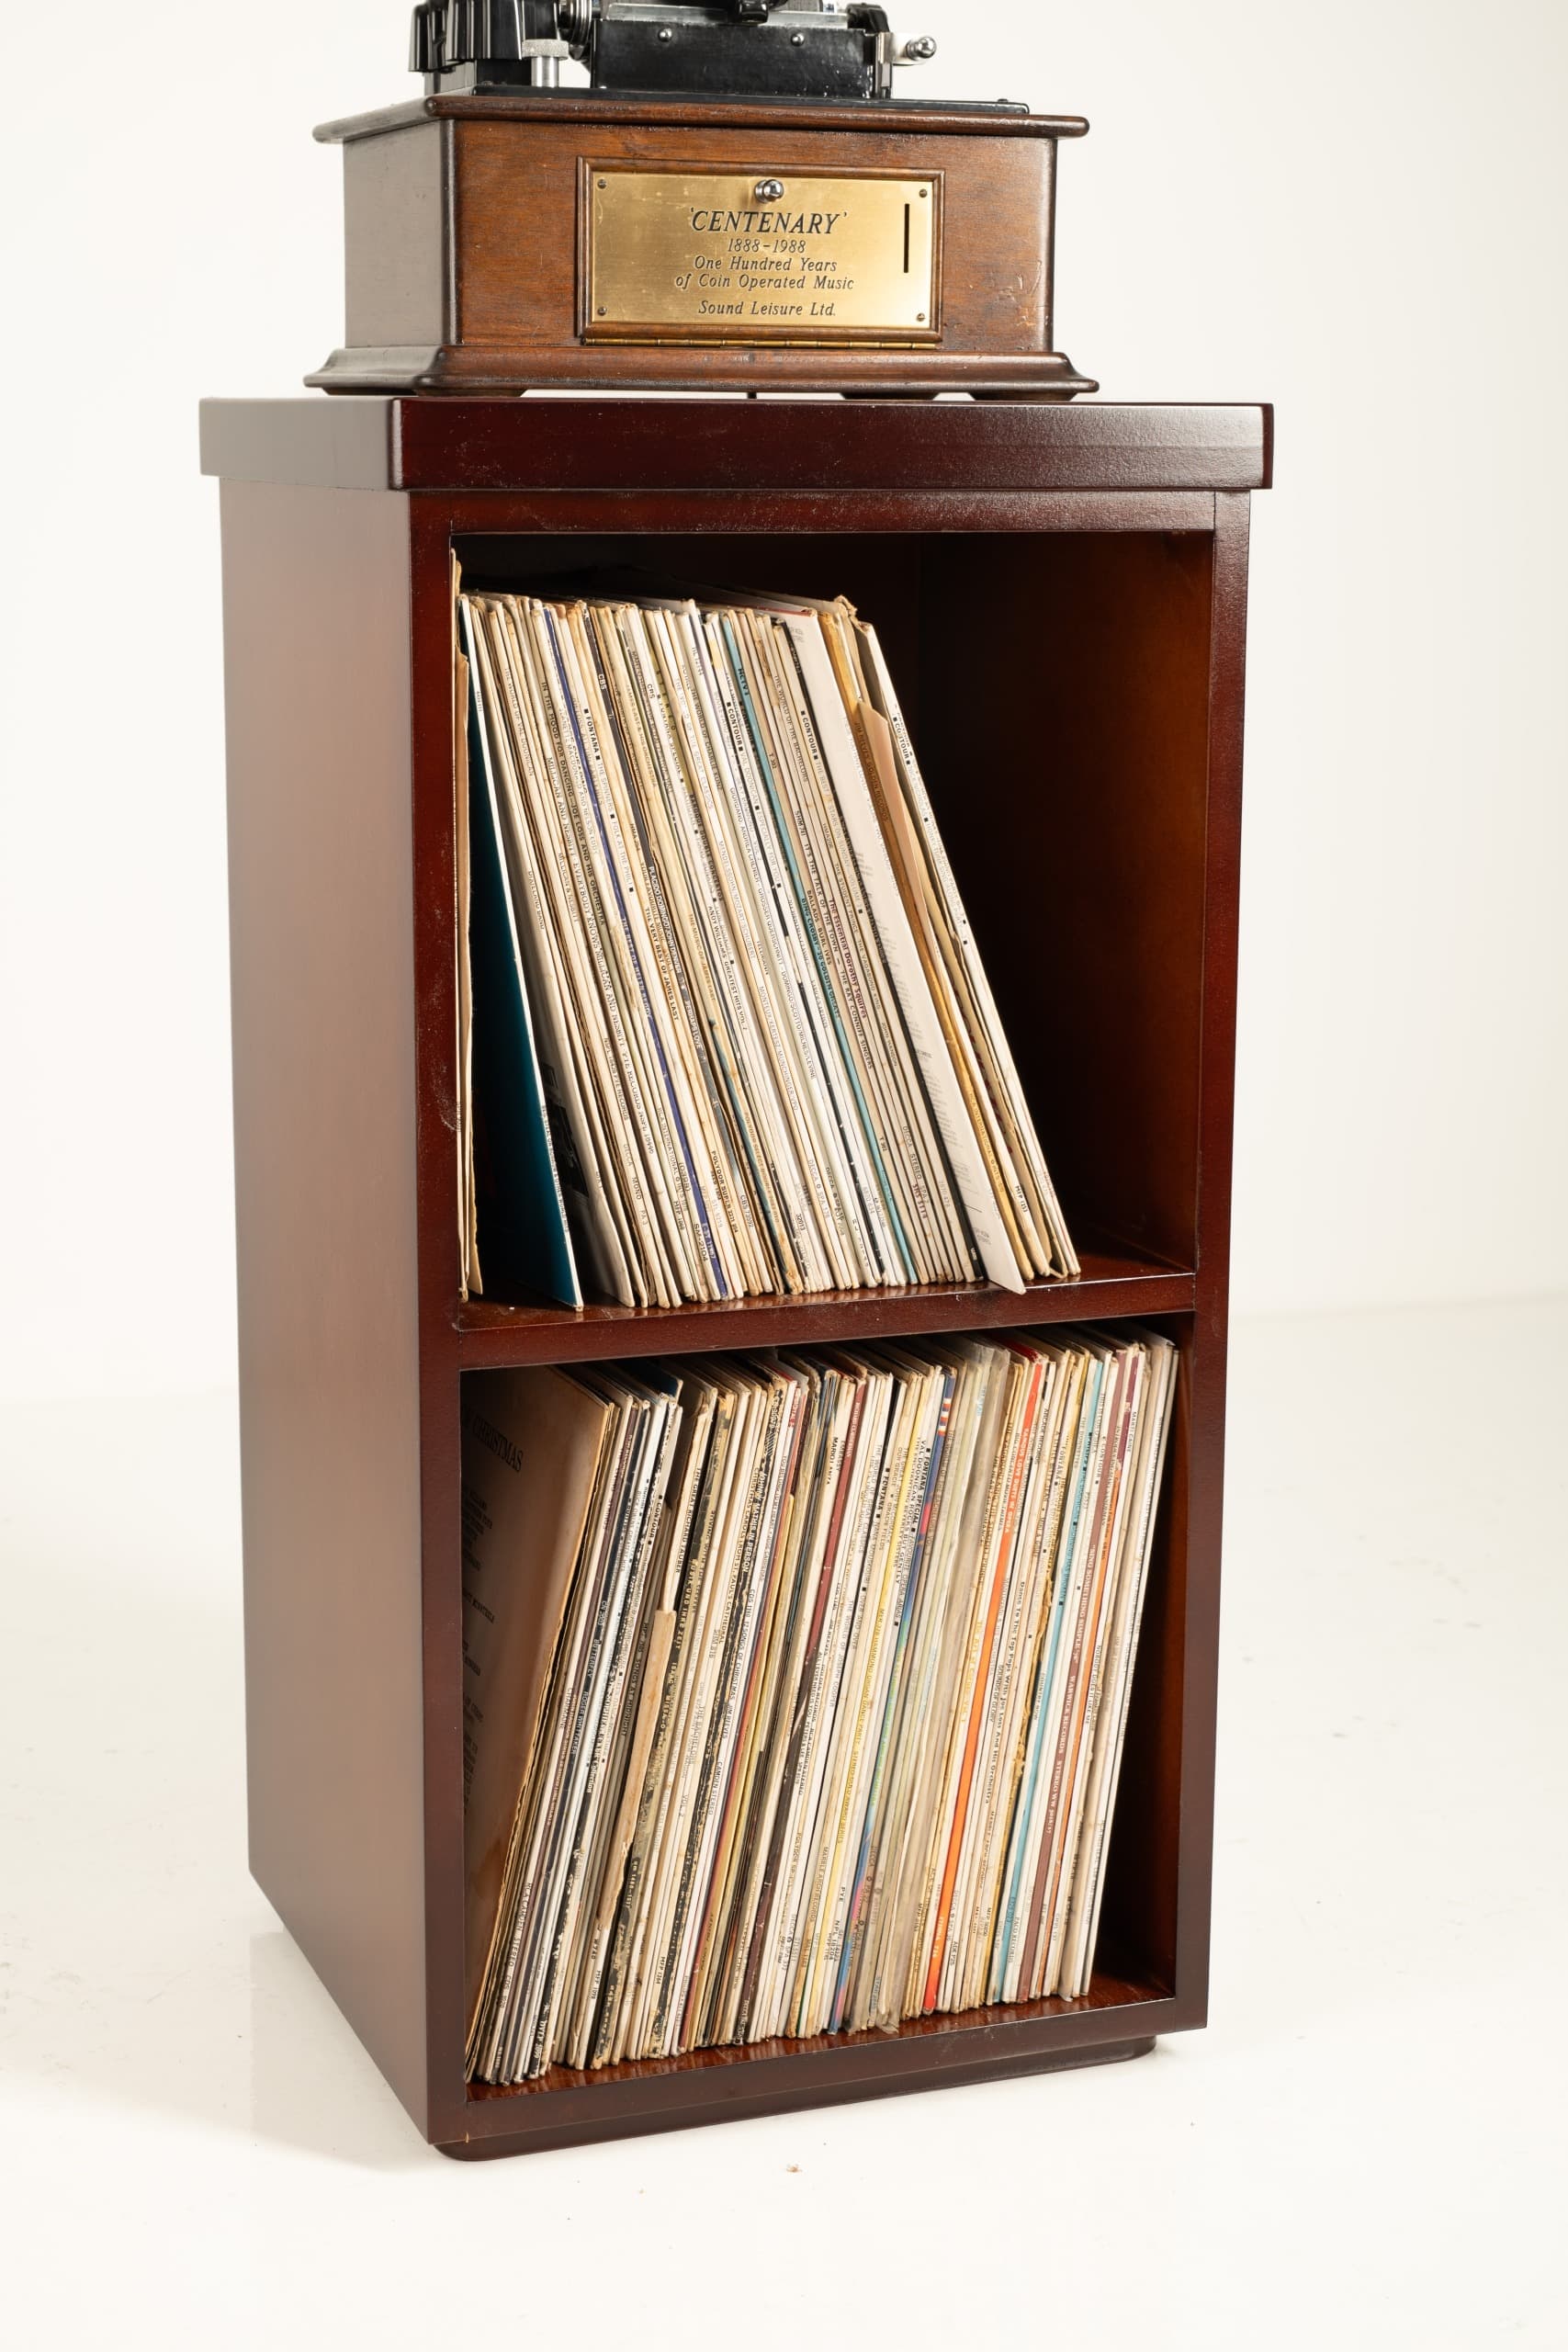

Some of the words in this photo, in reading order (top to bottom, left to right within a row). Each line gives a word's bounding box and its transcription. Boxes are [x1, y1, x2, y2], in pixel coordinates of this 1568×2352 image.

[694, 255, 722, 270] One
[730, 256, 792, 271] Hundred
[800, 257, 838, 272] Years
[675, 273, 692, 288] of
[699, 274, 730, 288] Coin
[739, 275, 805, 291] Operated
[813, 276, 854, 289] Music
[698, 300, 744, 315] Sound
[750, 301, 803, 316] Leisure
[810, 301, 836, 316] Ltd.
[597, 673, 607, 689] CBS
[645, 684, 656, 698] CBS
[773, 675, 781, 687] THE
[544, 695, 553, 710] THE
[776, 689, 789, 715] WORLD
[547, 713, 559, 738] MOOD
[726, 708, 742, 745] CONTOUR
[787, 728, 796, 740] THE
[555, 741, 564, 757] FOR
[689, 689, 698, 702] THE
[694, 705, 705, 728] WORLD
[703, 741, 717, 769] CHARLIE
[712, 772, 722, 790] KUNZ
[739, 752, 747, 761] VAL
[791, 741, 809, 782] BACHELORS
[584, 716, 599, 752] FONTANA
[596, 763, 604, 775] THE
[600, 777, 614, 812] SPINNERS
[610, 820, 620, 838] FOLK
[618, 851, 626, 863] THE
[741, 763, 759, 804] DOONICAN
[574, 822, 585, 840] LOSS
[580, 843, 590, 860] AND
[767, 855, 776, 866] FOR
[585, 864, 593, 876] HIS
[771, 869, 780, 881] YOU
[589, 880, 606, 925] ORCHESTRA
[827, 899, 837, 912] The
[806, 890, 820, 922] BALLADS
[816, 927, 828, 946] BURL
[823, 949, 833, 965] IVES
[831, 916, 849, 950] Essential
[644, 908, 652, 921] THE
[648, 923, 658, 942] VERY
[654, 944, 664, 964] BEST
[662, 977, 673, 999] JAMES
[669, 1001, 679, 1021] LAST
[647, 866, 660, 894] PLACIDO
[669, 947, 682, 973] DENVER
[683, 1001, 697, 1030] PERHAPS
[692, 1030, 703, 1048] LOVE
[707, 906, 717, 923] ANDY
[713, 925, 728, 957] WILLIAMS
[723, 961, 738, 993] GREATEST
[732, 995, 742, 1010] HITS
[841, 952, 859, 986] Dorothy
[853, 989, 868, 1018] Squires
[901, 1125, 913, 1147] DECCA
[908, 1153, 922, 1179] STEREO
[622, 1143, 634, 1166] DECCA
[630, 1176, 642, 1200] MONO
[711, 1151, 725, 1184] POLYDOR
[677, 1161, 691, 1192] (0398)
[693, 1223, 708, 1261] SM-2104
[795, 1214, 806, 1230] 32013
[1038, 1408, 1048, 1433] ARCADE
[918, 1440, 926, 1455] VAL
[1018, 1428, 1029, 1456] FAMOUS
[1033, 1435, 1043, 1464] RECORDS
[1125, 1433, 1134, 1453] CAINE
[693, 1467, 701, 1482] THE
[909, 1456, 922, 1500] DOONICAN
[918, 1456, 930, 1490] FONTANA
[1014, 1458, 1023, 1476] LOVE
[688, 1484, 697, 1506] GREAT
[754, 1471, 767, 1500] JOHNNY
[876, 1476, 888, 1510] FONTANA
[1010, 1478, 1020, 1499] DUETS
[648, 1501, 661, 1539] CONTOUR
[749, 1503, 761, 1531] MATHIS
[904, 1504, 914, 1529] ROCKS
[912, 1494, 922, 1524] SPECIAL
[1004, 1510, 1013, 1533] OPERA
[681, 1510, 693, 1543] RICHARD
[871, 1521, 880, 1540] NANA
[900, 1533, 908, 1549] BUT
[674, 1544, 685, 1573] TAUBER
[740, 1542, 753, 1573] PERSON
[863, 1542, 875, 1584] MOUSKOURI
[894, 1552, 905, 1584] GENTLY
[898, 1574, 908, 1596] OPERA
[1016, 1581, 1025, 1605] Dance
[1078, 1568, 1091, 1618] SOMETHING
[845, 1600, 853, 1613] THE
[857, 1595, 866, 1613] OVER
[894, 1599, 903, 1618] ARIAS
[840, 1615, 851, 1639] WORLD
[854, 1615, 863, 1630] AND
[1073, 1619, 1084, 1648] SIMPLE
[851, 1632, 859, 1649] OVER
[1008, 1636, 1016, 1651] Top
[630, 1657, 641, 1683] SONGS
[833, 1653, 844, 1679] JOSEPH
[1004, 1653, 1013, 1672] Pops
[828, 1680, 839, 1707] COOPER
[1001, 1675, 1010, 1696] With
[1064, 1675, 1075, 1714] WARWICK
[558, 1687, 573, 1730] CHARMAINE
[998, 1697, 1007, 1711] Joe
[620, 1699, 633, 1737] MIDNIGHT
[996, 1713, 1004, 1728] Loss
[993, 1731, 1001, 1747] And
[1057, 1715, 1069, 1754] RECORDS
[585, 1759, 598, 1793] Collection
[984, 1765, 996, 1804] Orchestra
[1051, 1759, 1062, 1792] STEREO
[838, 1886, 846, 1903] PYE
[831, 1919, 840, 1938] NPL
[590, 1985, 598, 1999] 1098
